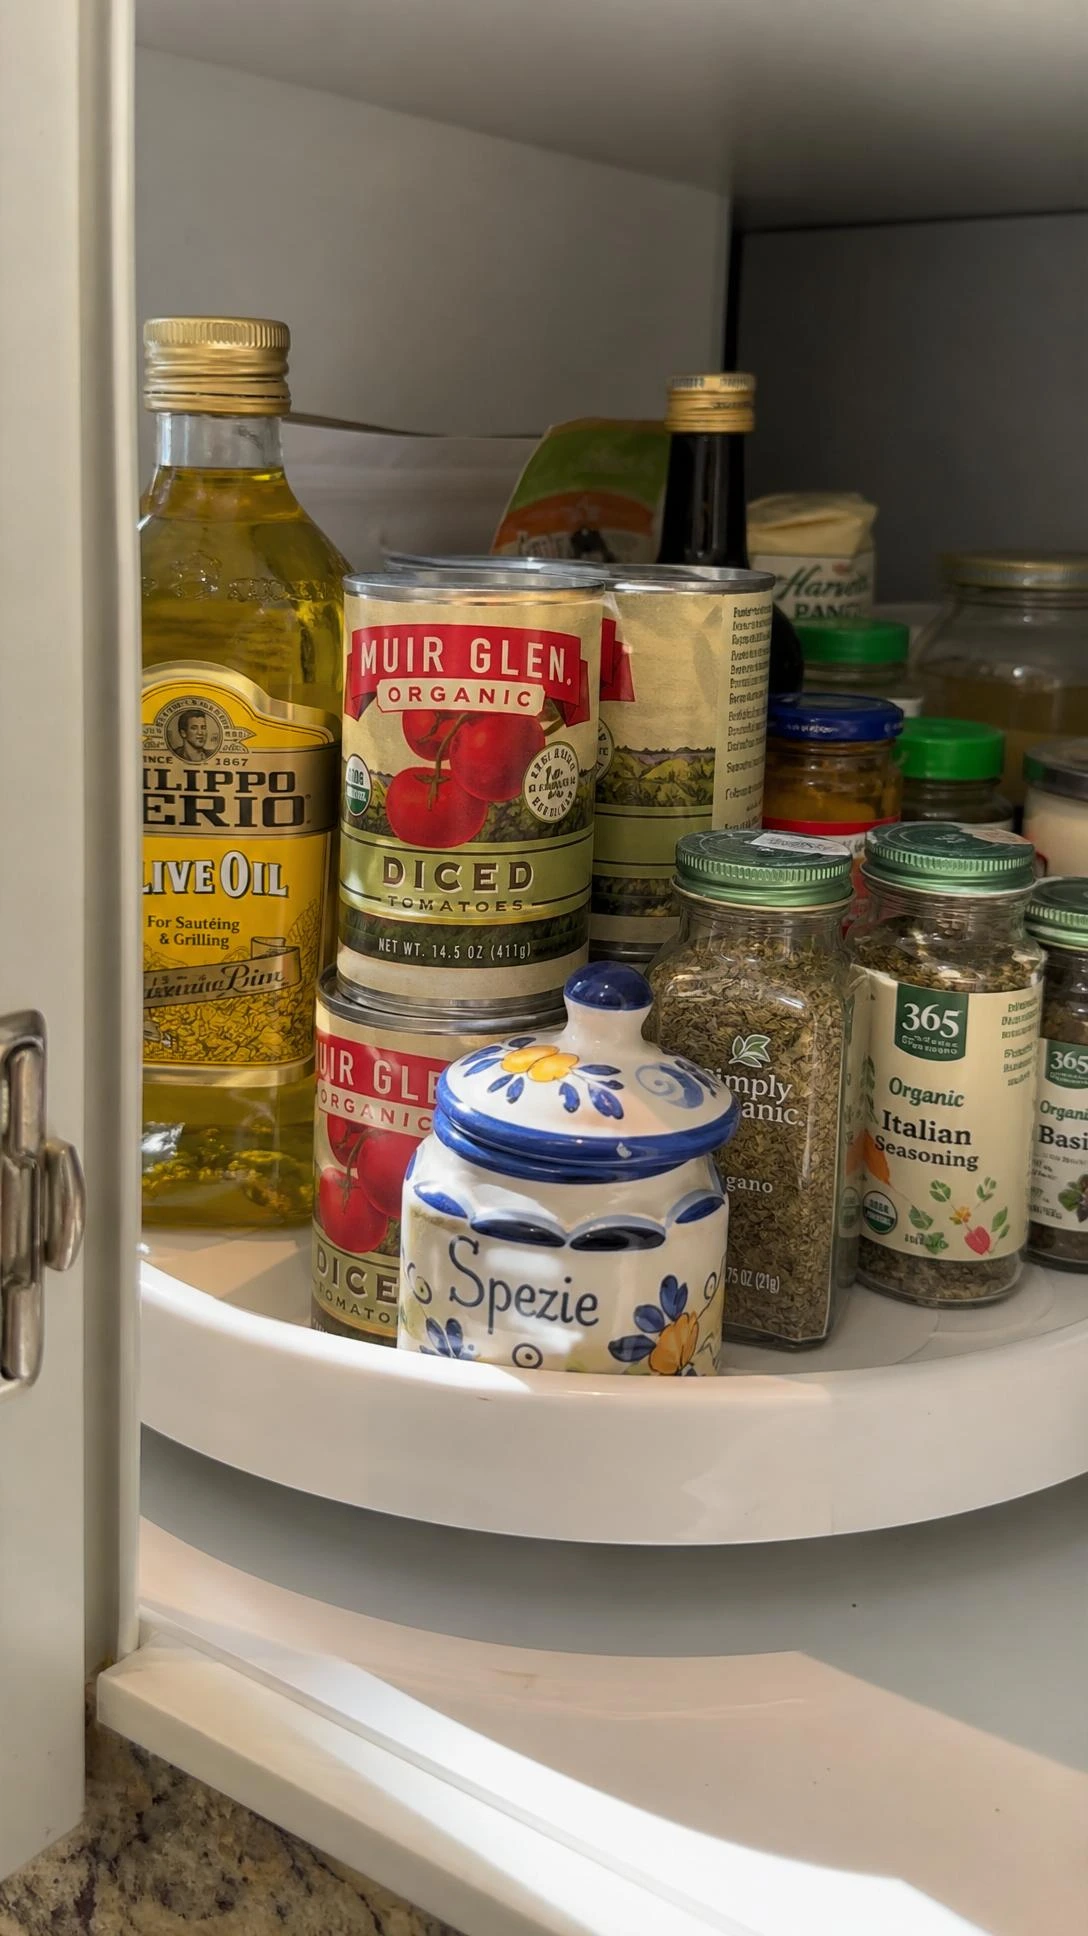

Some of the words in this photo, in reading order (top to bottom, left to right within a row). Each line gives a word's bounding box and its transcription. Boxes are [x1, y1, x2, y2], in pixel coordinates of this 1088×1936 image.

[360, 637, 444, 677] MUIR
[387, 686, 532, 708] ORGANIC
[143, 755, 173, 764] INCE
[215, 757, 249, 767] 1867
[143, 793, 305, 828] ERIO
[220, 850, 289, 899] OIL
[382, 855, 535, 895] DICED
[387, 895, 523, 912] TOMATOES
[147, 915, 172, 929] For
[175, 916, 240, 934] Sautéing
[159, 933, 169, 945] &
[173, 933, 230, 950] Grilling
[378, 937, 402, 954] NET
[403, 940, 425, 957] WT.
[432, 944, 460, 959] 14.5
[467, 946, 484, 959] OZ
[490, 943, 532, 960] (411g)
[901, 1003, 963, 1039] 365
[1050, 1051, 1088, 1074] 365
[373, 1059, 443, 1105] GLE
[888, 1077, 965, 1107] Organic
[320, 1088, 432, 1132] ORGANIC
[881, 1109, 972, 1146] Italian
[875, 1135, 980, 1173] Seasoning
[1039, 1124, 1088, 1151] Basi
[317, 1243, 400, 1306] DICE
[448, 1235, 599, 1335] Spezie
[740, 1268, 753, 1287] OZ
[755, 1271, 780, 1295] (21g)
